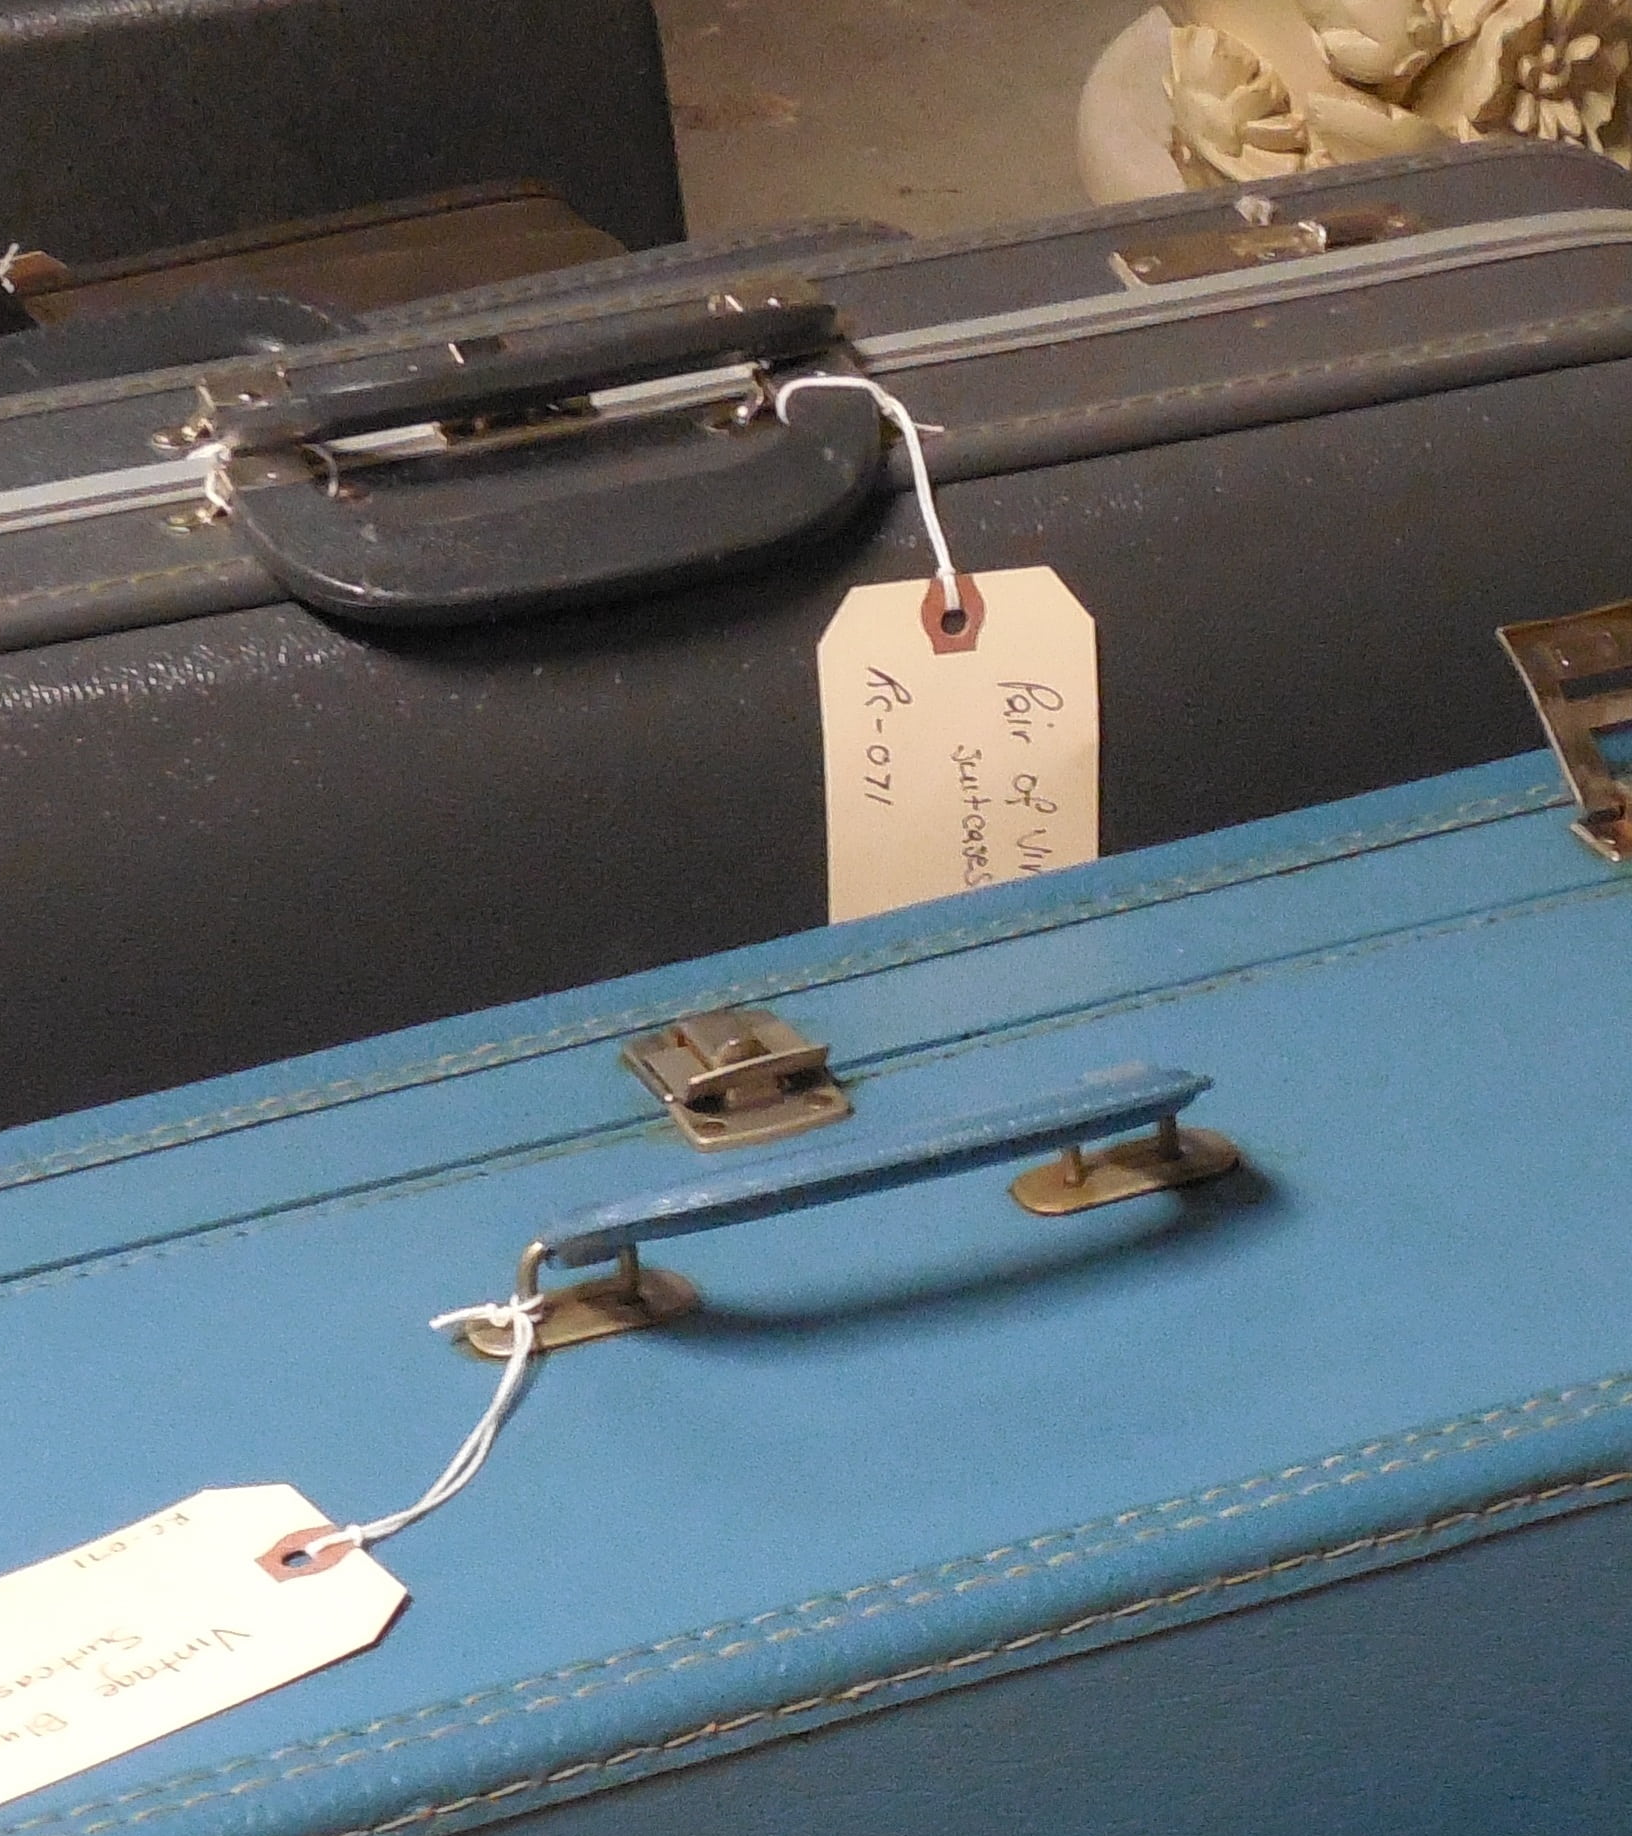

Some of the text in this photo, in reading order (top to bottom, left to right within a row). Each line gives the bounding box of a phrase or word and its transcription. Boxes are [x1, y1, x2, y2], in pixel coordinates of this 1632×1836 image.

[996, 682, 1063, 744] Pair
[1004, 774, 1057, 813] of
[96, 1624, 252, 1700] Vintage
